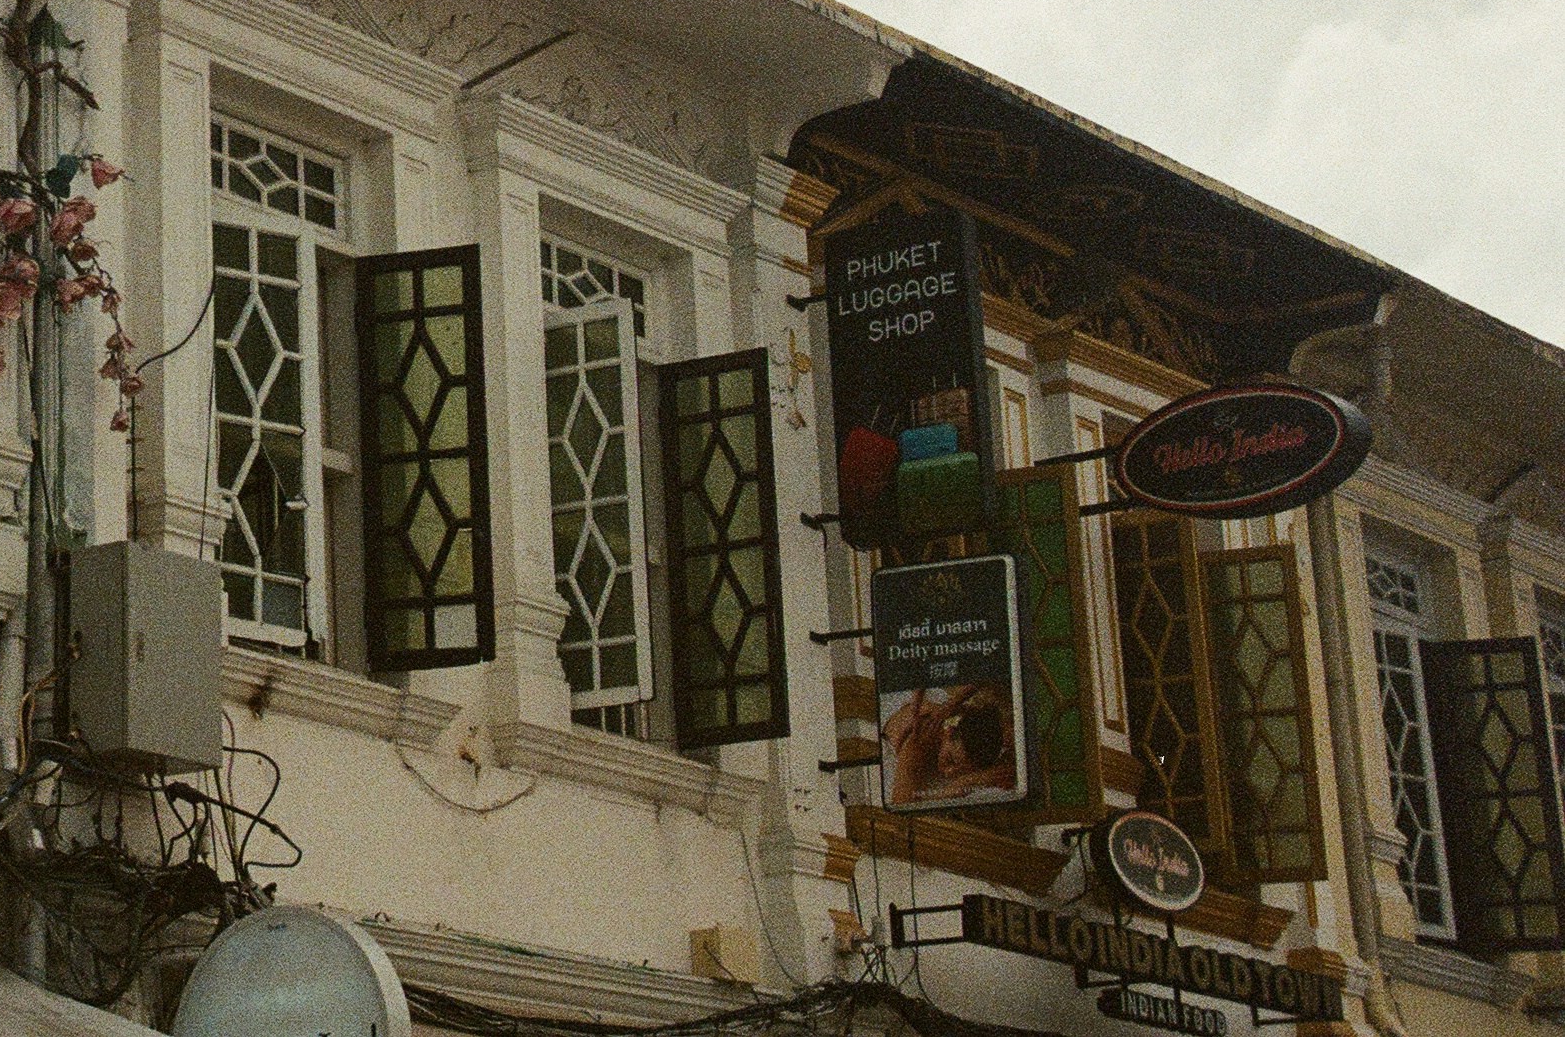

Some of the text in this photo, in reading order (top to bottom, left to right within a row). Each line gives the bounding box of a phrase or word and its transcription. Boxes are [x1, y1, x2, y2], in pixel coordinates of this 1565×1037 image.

[847, 240, 941, 281] PHUKET
[838, 272, 958, 316] LUGGAGE
[868, 310, 935, 342] SHOP
[1153, 422, 1310, 475] Hello India
[888, 637, 1001, 662] Deity massage
[982, 896, 1342, 1018] HELLO INDIA OLD TOWN
[1120, 990, 1228, 1037] INDIAN FOOD
